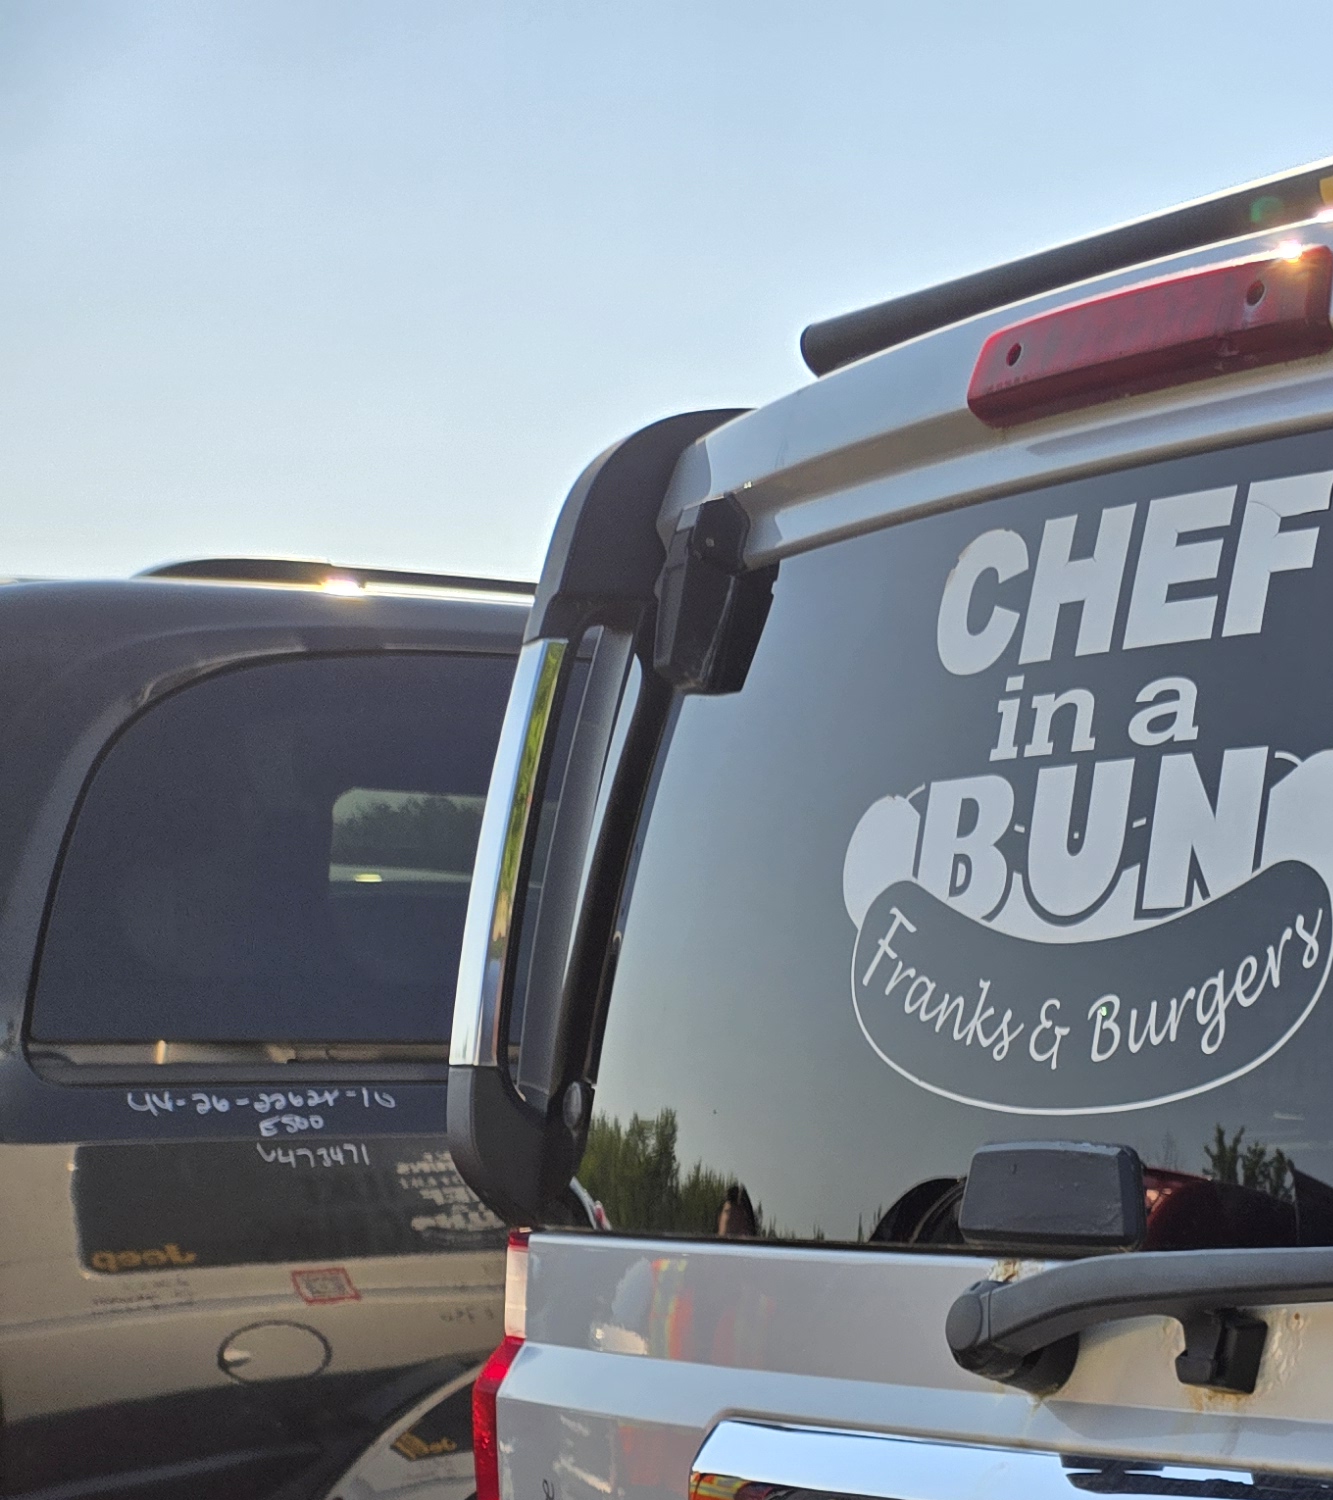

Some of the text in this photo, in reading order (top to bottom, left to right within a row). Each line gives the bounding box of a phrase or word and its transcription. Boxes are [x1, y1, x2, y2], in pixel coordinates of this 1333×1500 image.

[988, 674, 1199, 762] in a
[917, 745, 1269, 918] BUN
[862, 906, 1322, 1069] Franks & Burgers
